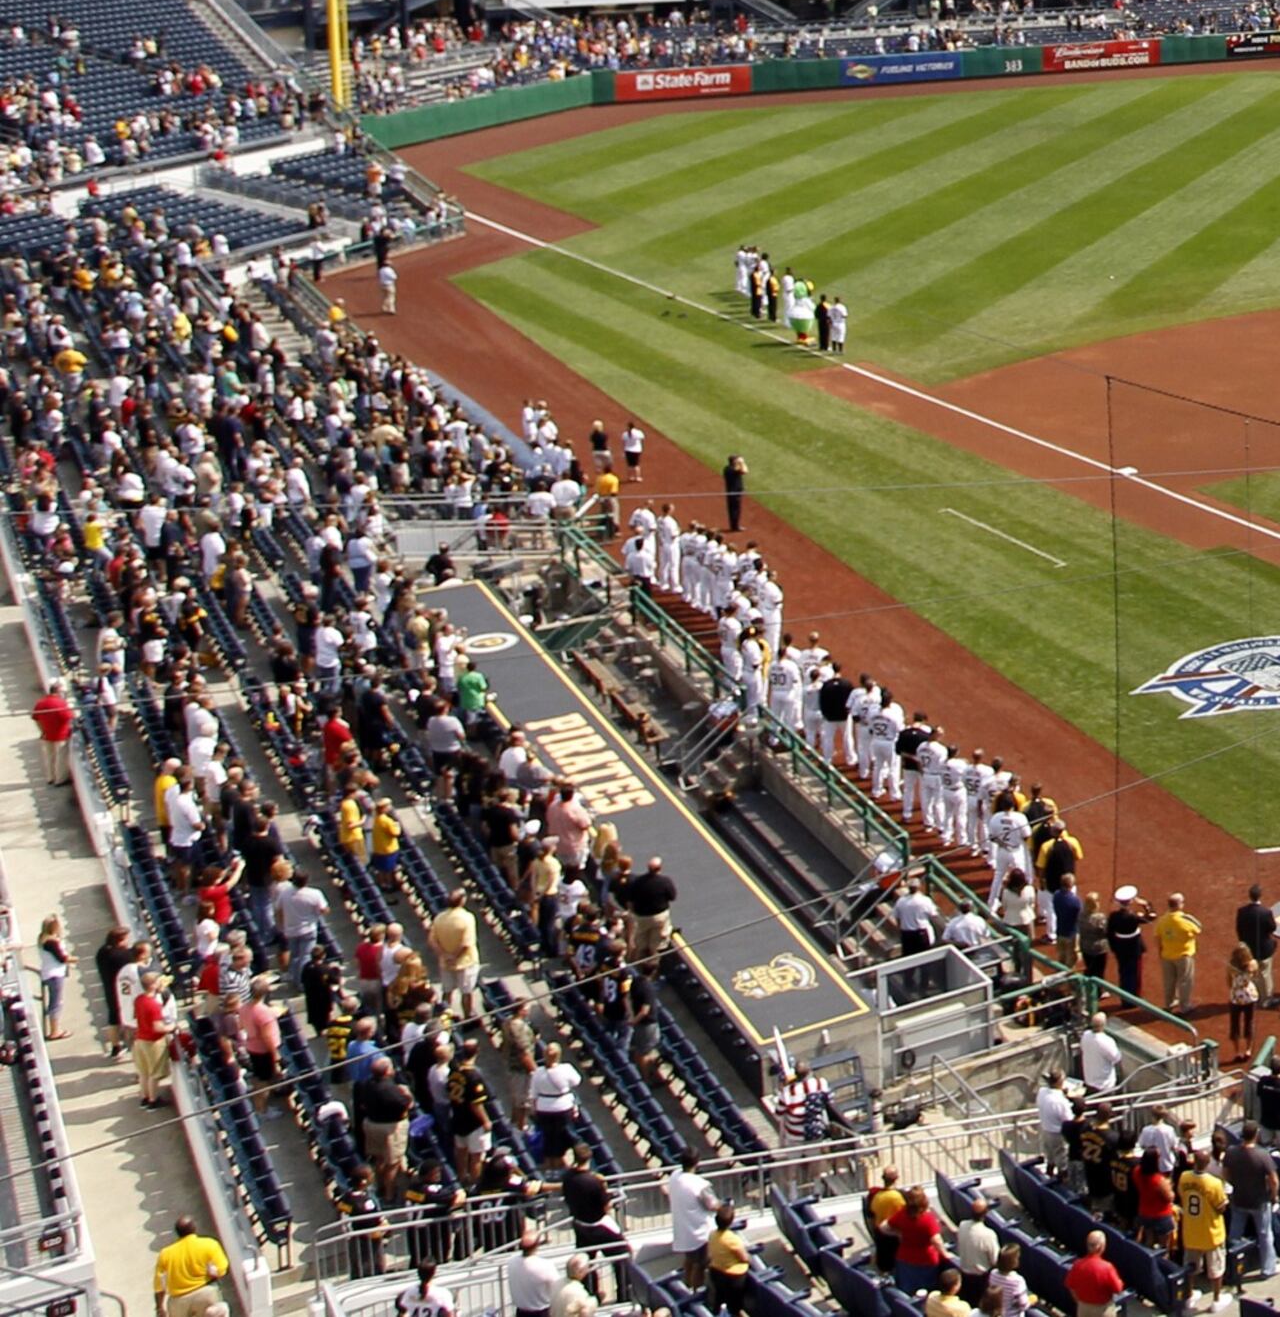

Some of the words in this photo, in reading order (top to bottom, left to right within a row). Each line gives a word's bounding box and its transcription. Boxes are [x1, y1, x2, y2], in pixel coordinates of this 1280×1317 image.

[1004, 59, 1023, 73] 383
[655, 73, 693, 89] State
[694, 71, 731, 86] Farm
[770, 673, 787, 686] 30
[1210, 695, 1270, 707] SHALL
[873, 723, 888, 736] 52
[524, 710, 657, 816] PIRATES
[1188, 1194, 1200, 1217] 8
